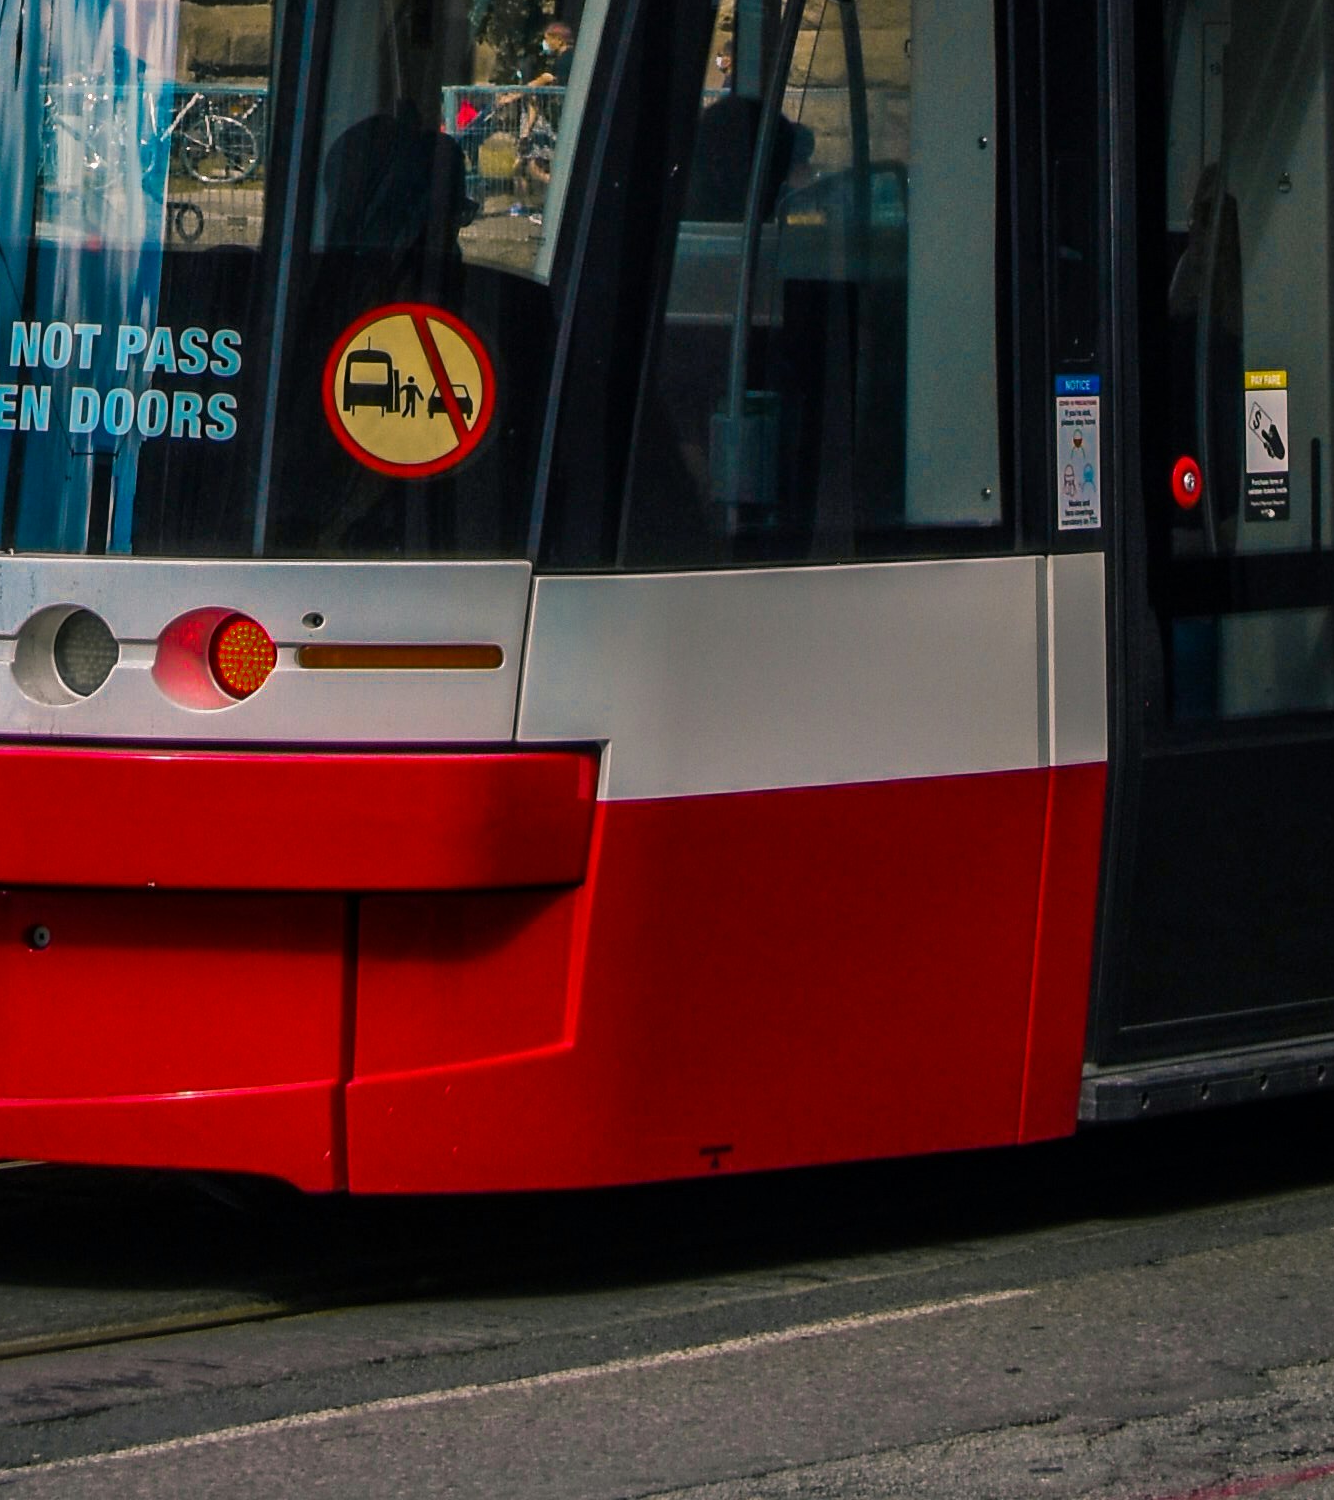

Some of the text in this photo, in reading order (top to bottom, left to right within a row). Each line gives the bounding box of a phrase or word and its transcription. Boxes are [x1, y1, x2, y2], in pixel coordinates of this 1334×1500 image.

[9, 321, 102, 371] NOT
[115, 324, 244, 378] PASS
[1065, 379, 1091, 390] NOTICE
[1264, 374, 1282, 385] FARE
[68, 387, 238, 440] DOORS
